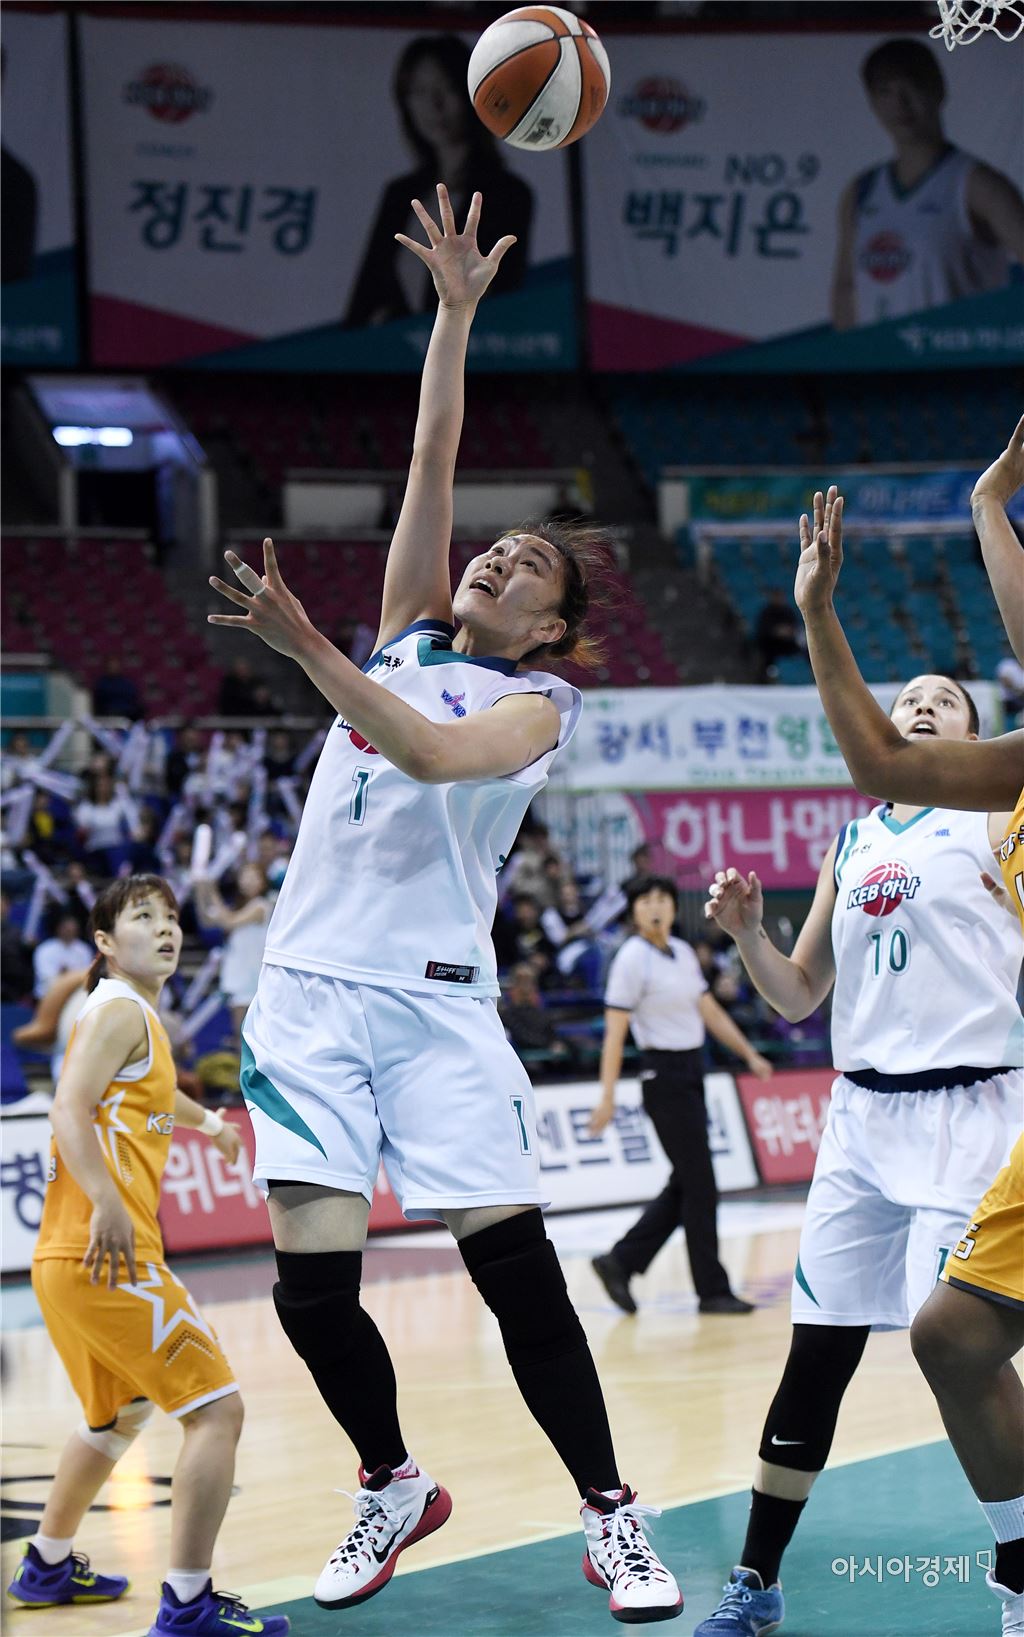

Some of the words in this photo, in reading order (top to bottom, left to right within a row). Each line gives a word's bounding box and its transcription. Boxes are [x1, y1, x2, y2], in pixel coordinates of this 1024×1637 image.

[130, 178, 321, 256] 정진경
[623, 189, 812, 260] 백지은
[349, 766, 374, 826] 1
[847, 884, 880, 909] KEB
[881, 877, 921, 899] 하나
[866, 925, 911, 980] 10
[509, 1094, 532, 1156] 1
[162, 1140, 266, 1214] 위더
